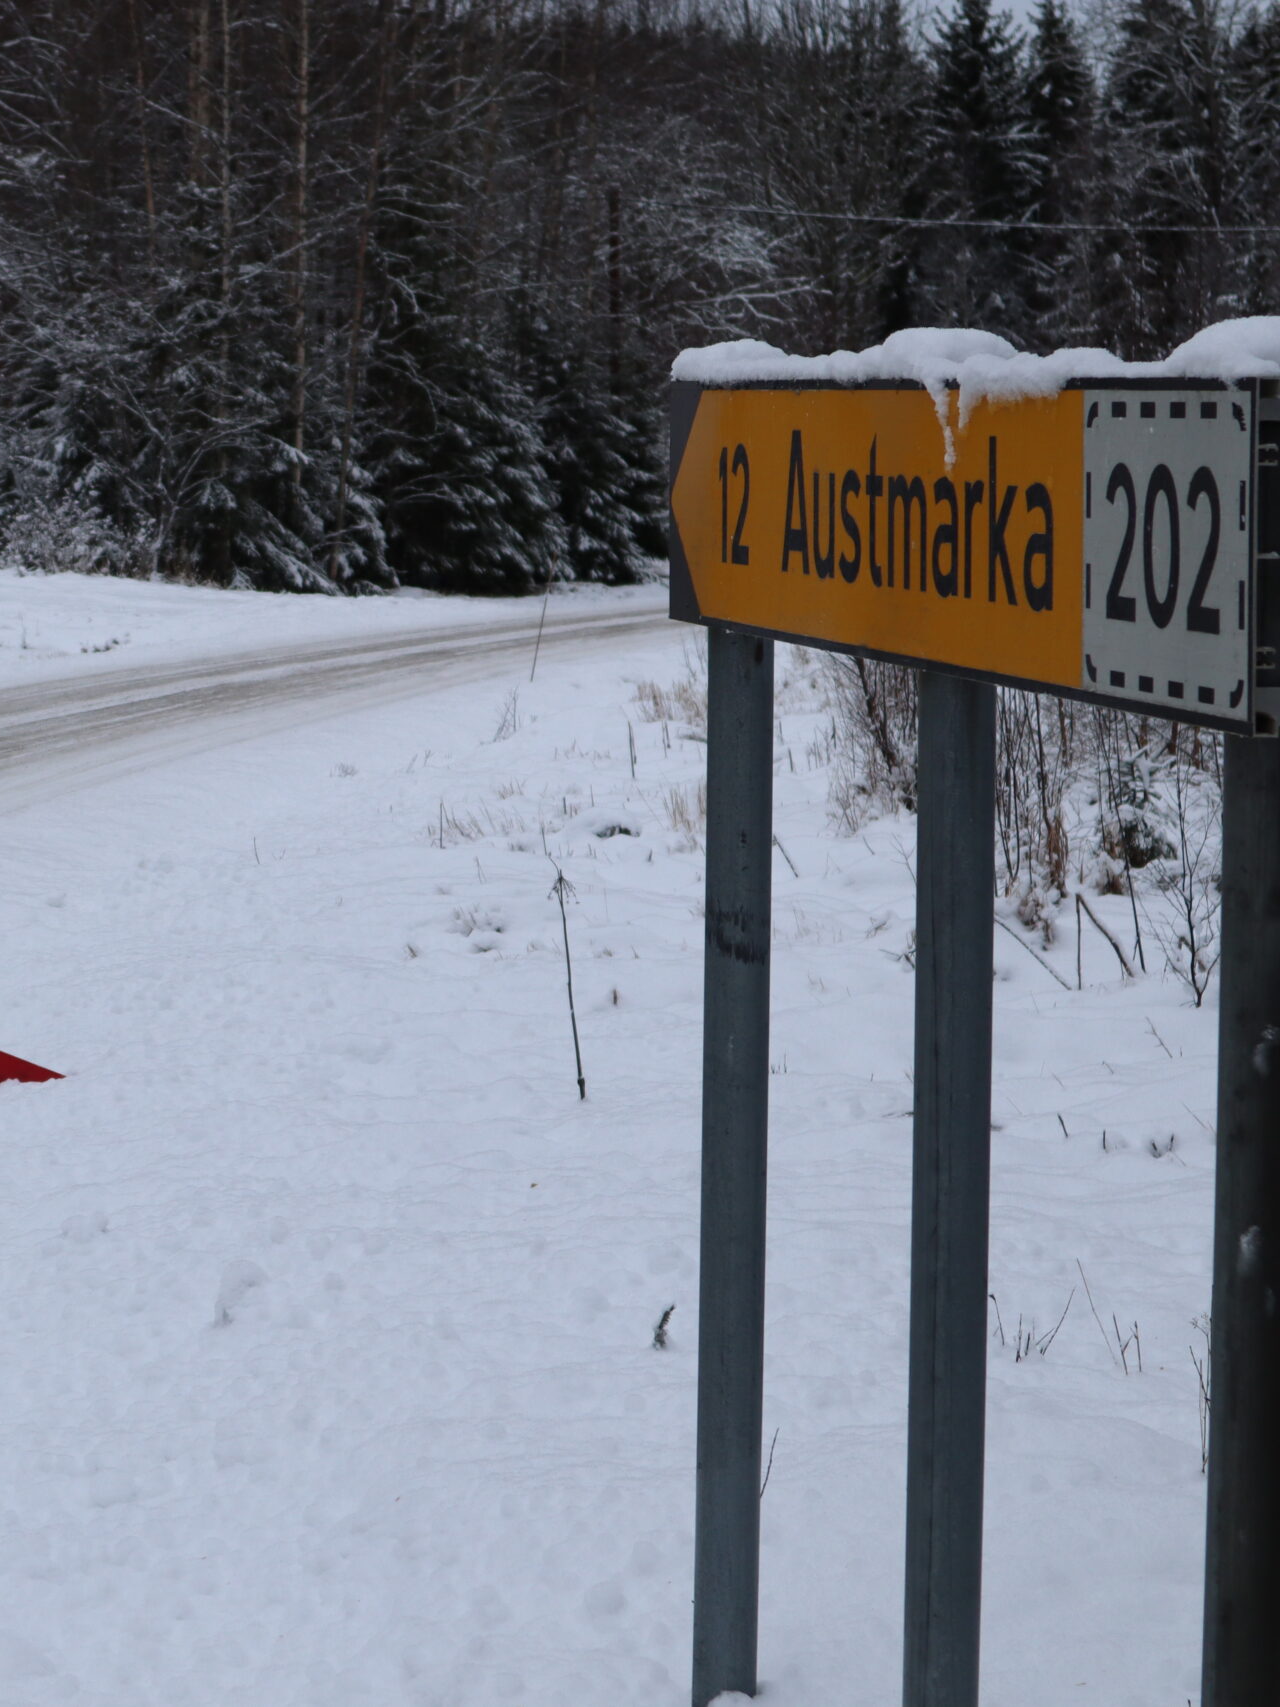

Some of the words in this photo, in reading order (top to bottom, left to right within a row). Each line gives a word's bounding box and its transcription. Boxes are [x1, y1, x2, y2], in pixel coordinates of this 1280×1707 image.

[718, 442, 750, 567] 12
[780, 429, 1054, 613] Austmarka
[1105, 461, 1221, 635] 202
